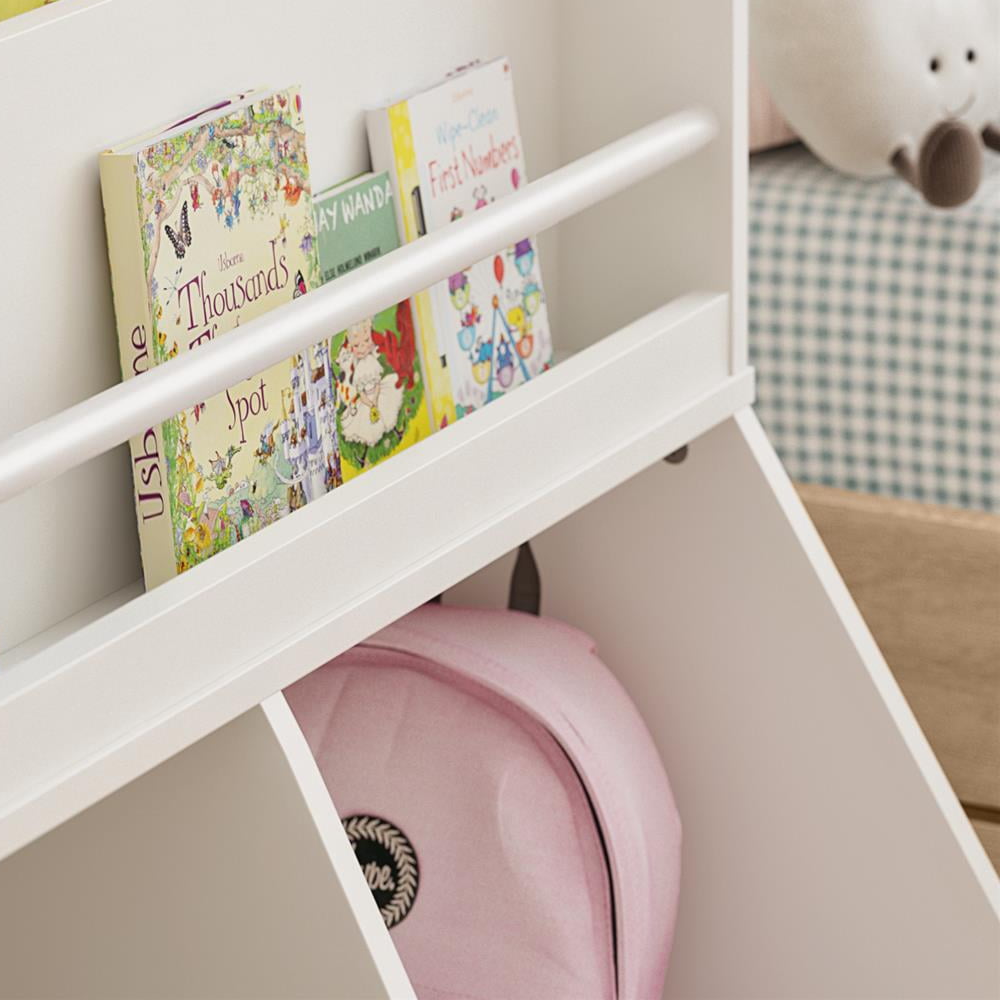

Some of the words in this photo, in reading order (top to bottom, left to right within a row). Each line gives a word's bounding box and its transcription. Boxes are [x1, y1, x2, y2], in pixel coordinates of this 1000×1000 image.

[428, 156, 464, 200] First
[461, 132, 520, 177] Numbers
[177, 239, 290, 332] Thousands
[217, 253, 246, 273] Usborne
